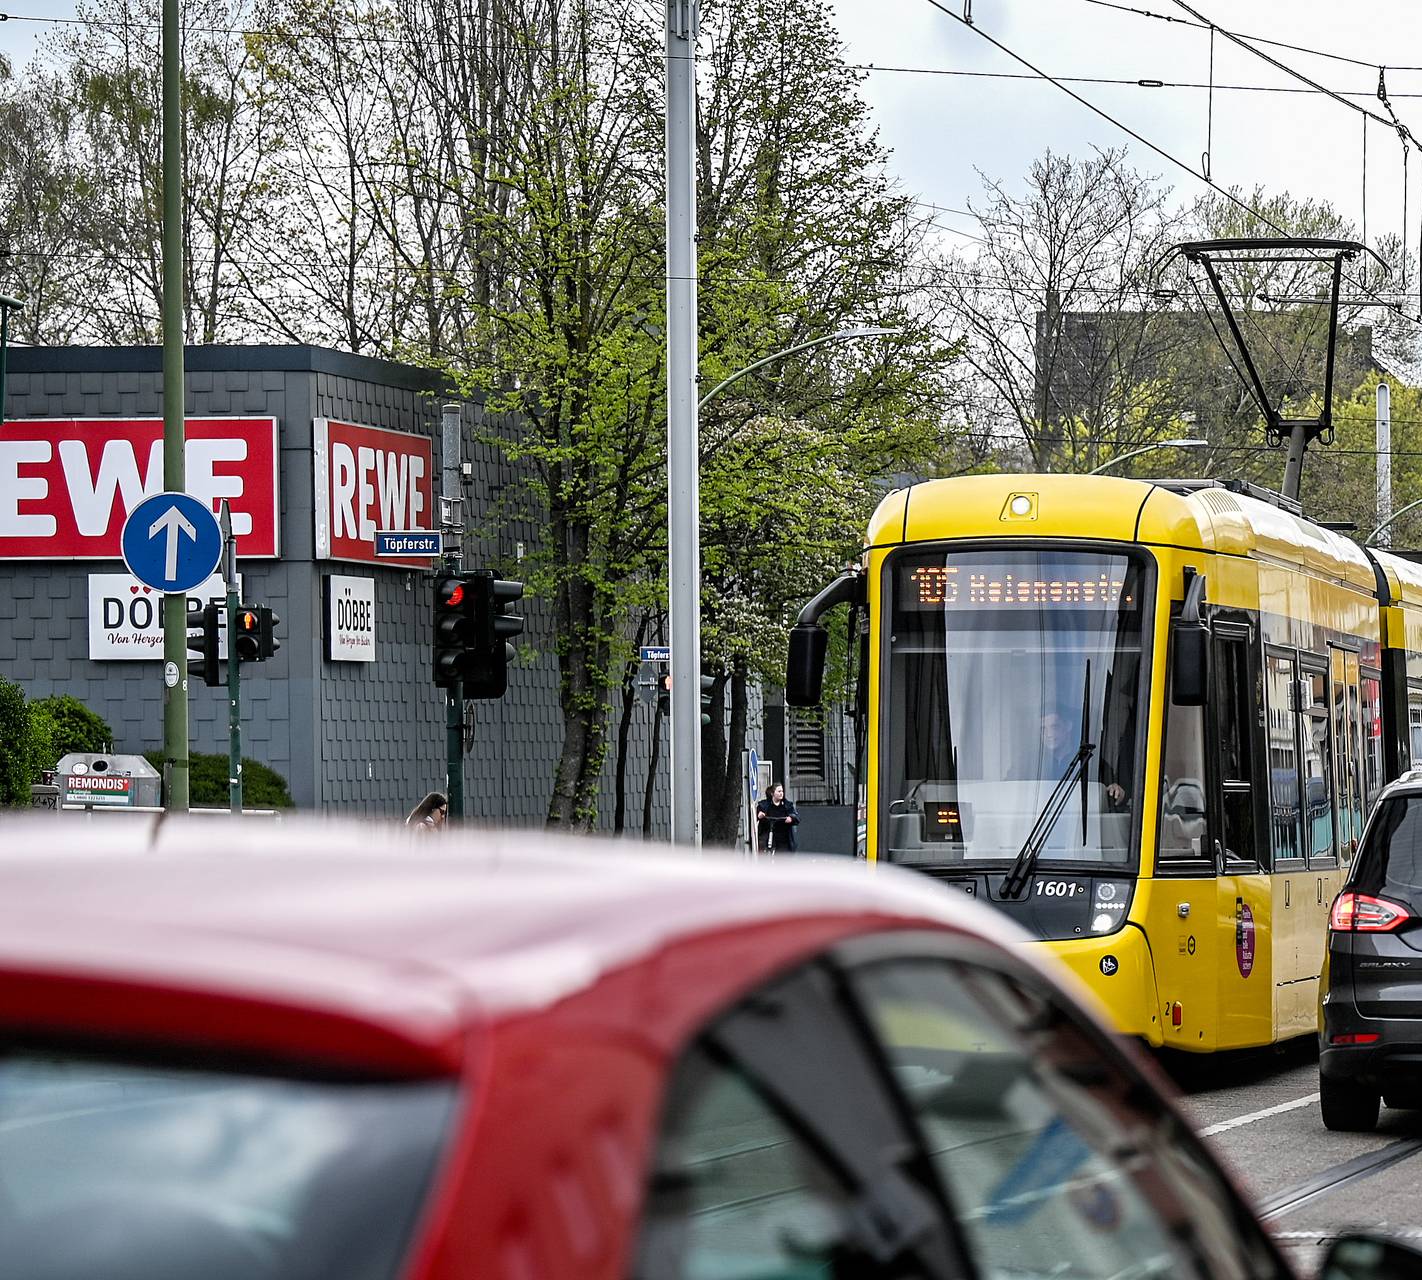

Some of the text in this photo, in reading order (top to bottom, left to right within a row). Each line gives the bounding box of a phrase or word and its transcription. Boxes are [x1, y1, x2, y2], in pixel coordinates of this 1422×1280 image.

[332, 442, 425, 542] REWE
[384, 536, 437, 552] Töpferstr.
[337, 588, 372, 632] DÖBBE
[107, 633, 129, 645] Von
[68, 777, 124, 790] REMONDIS
[1036, 881, 1076, 897] 1601
[1165, 1001, 1170, 1016] 2
